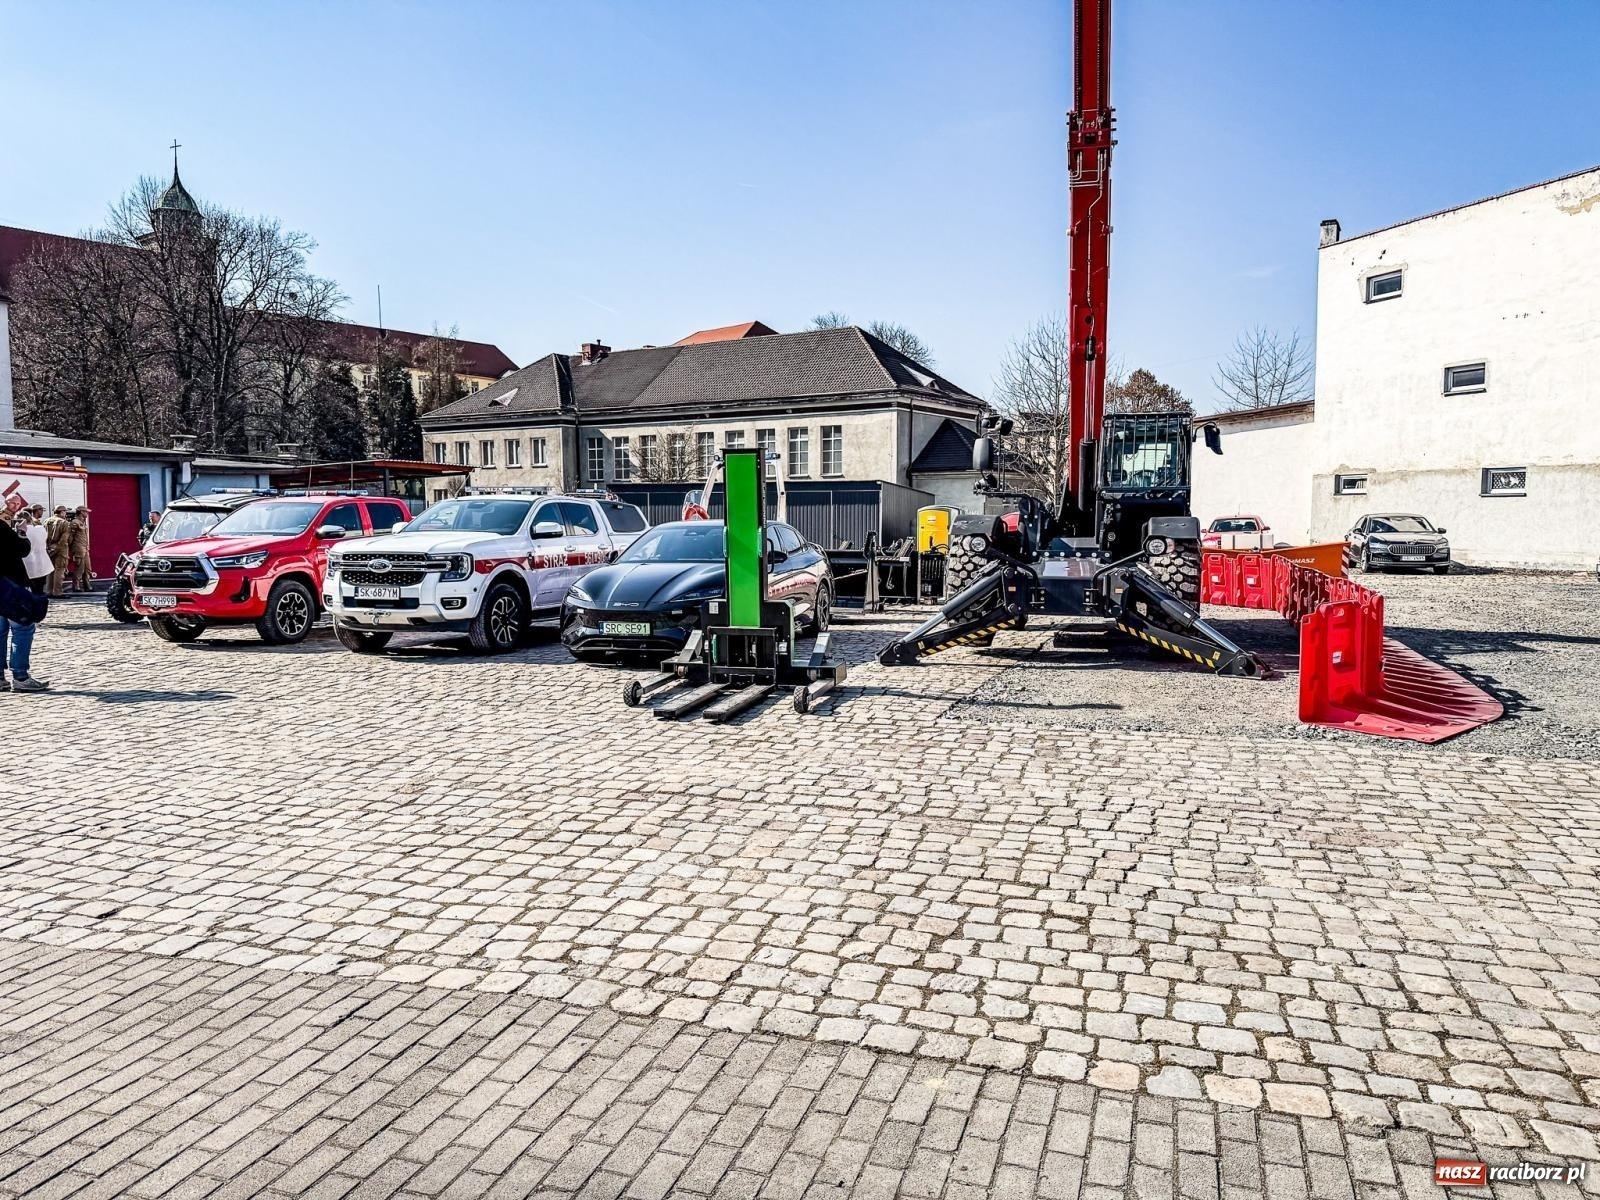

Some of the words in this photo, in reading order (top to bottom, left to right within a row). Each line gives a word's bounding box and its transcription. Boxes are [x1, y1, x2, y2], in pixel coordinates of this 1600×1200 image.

[360, 587, 370, 598] SK
[372, 587, 398, 598] 687YM
[143, 596, 152, 605] SK
[605, 623, 622, 633] SRC
[625, 623, 647, 634] SE91
